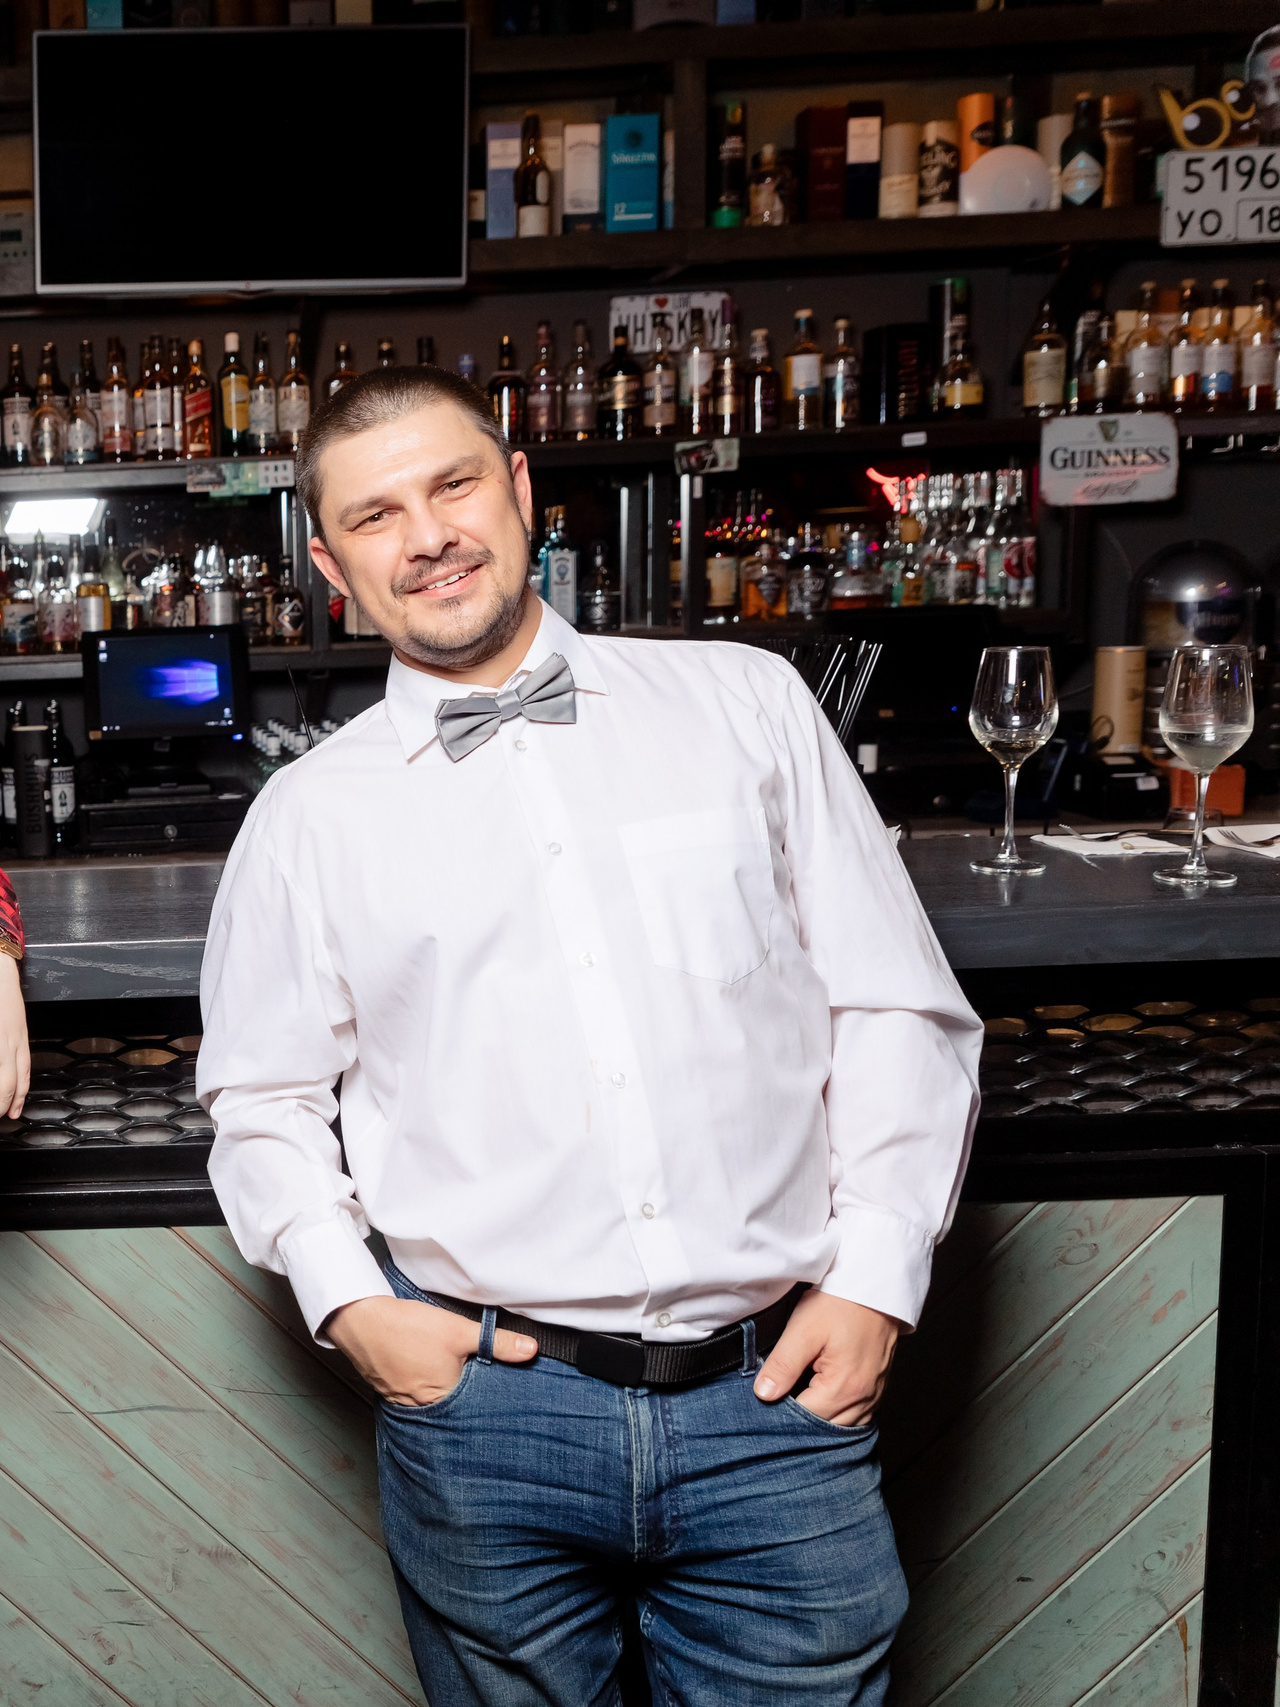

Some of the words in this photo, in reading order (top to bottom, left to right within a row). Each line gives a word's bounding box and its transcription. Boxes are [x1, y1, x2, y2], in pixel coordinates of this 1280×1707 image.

[1183, 153, 1280, 194] 5196
[1049, 445, 1171, 471] GUINNESS
[24, 753, 43, 834] BUSHMILLS
